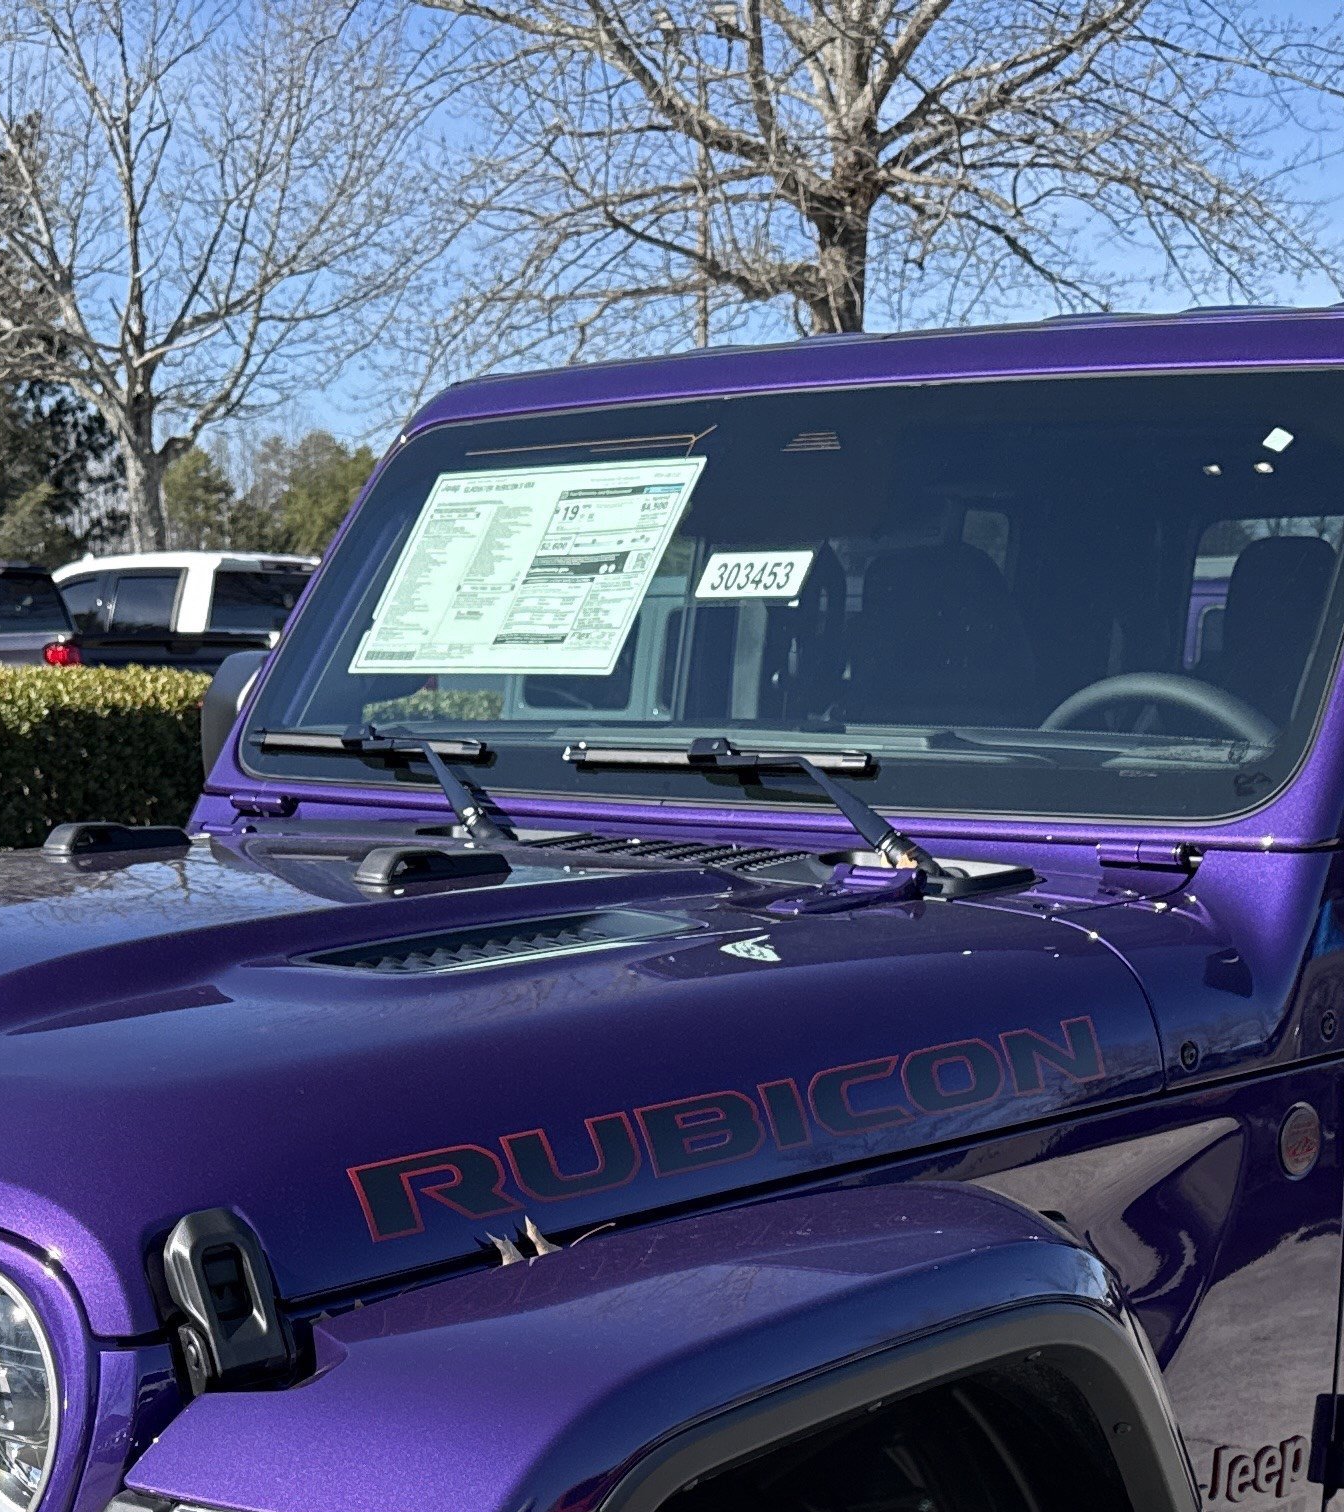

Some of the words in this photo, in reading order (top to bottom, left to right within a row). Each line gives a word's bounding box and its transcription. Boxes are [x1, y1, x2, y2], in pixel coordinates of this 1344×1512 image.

[562, 504, 580, 521] 19
[710, 562, 795, 591] 303453
[346, 1015, 1106, 1243] RUBICON
[1207, 1435, 1311, 1503] Jeep
